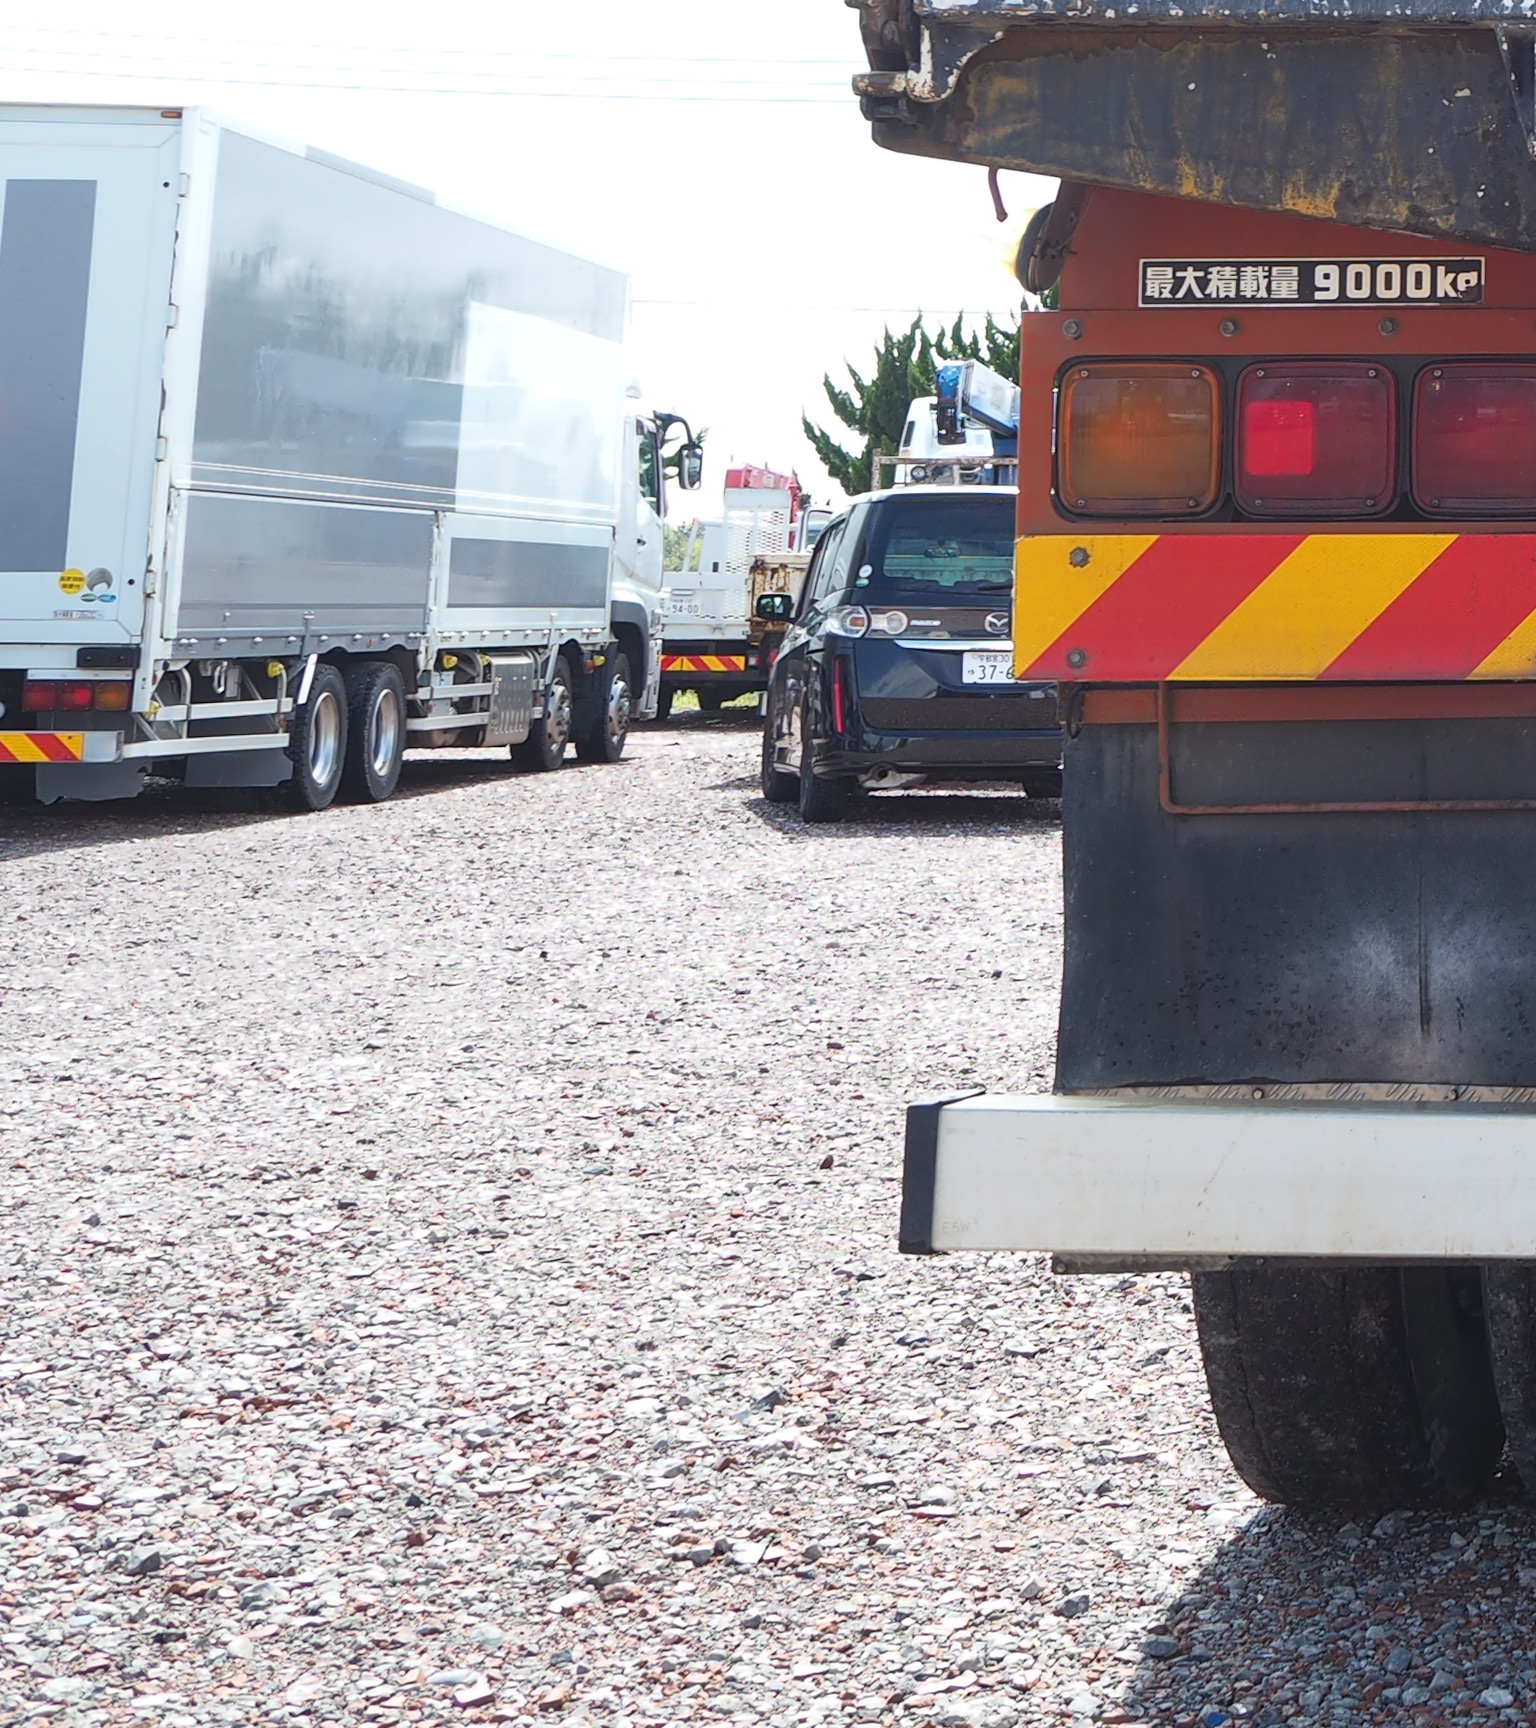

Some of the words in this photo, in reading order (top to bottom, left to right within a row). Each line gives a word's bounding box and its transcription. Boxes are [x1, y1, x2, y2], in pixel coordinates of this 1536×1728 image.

[1145, 266, 1300, 299] 最大積載量
